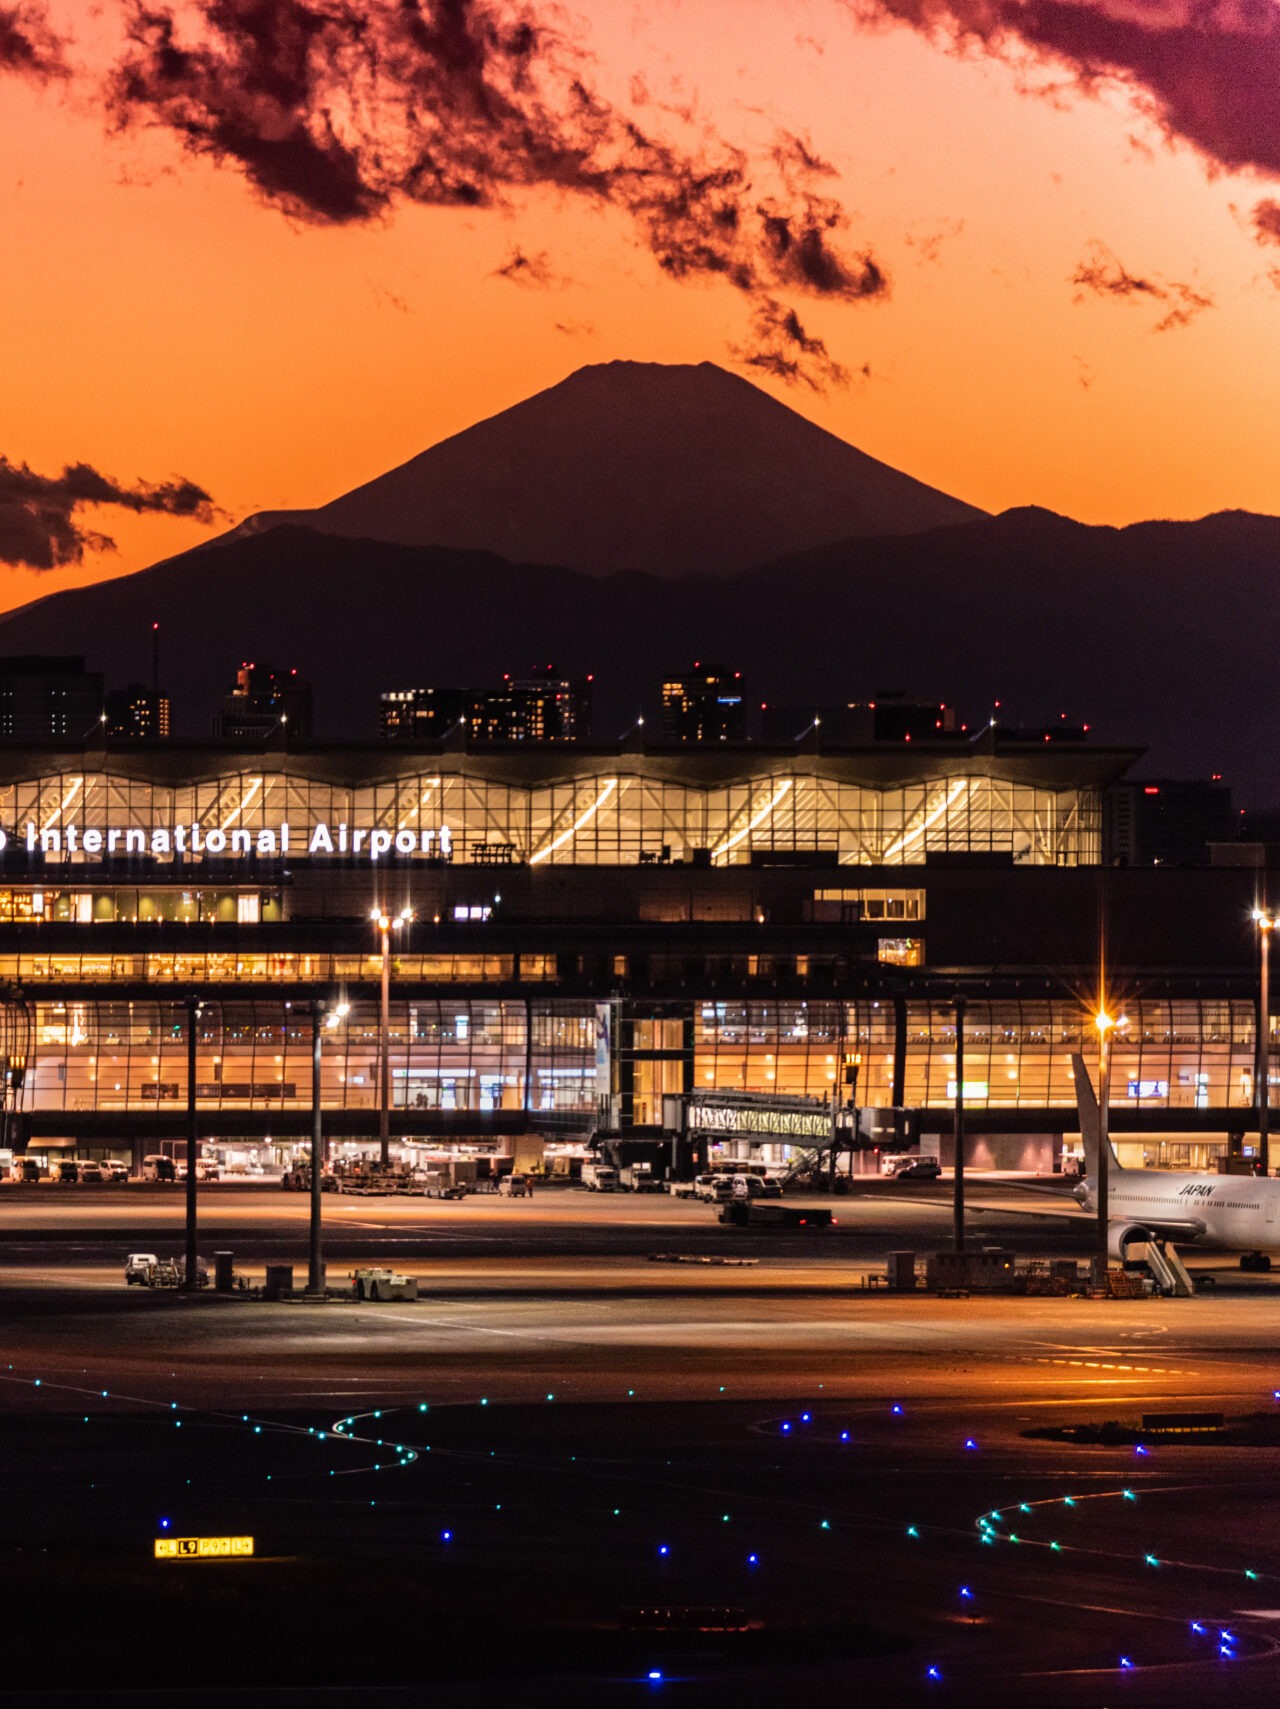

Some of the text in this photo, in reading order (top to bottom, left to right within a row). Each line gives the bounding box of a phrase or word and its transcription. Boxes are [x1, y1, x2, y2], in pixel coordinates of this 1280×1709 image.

[26, 821, 290, 853] International
[308, 821, 452, 860] Airport
[1179, 1184, 1216, 1197] JAPAN
[179, 1541, 197, 1554] L9
[202, 1541, 219, 1554] P9
